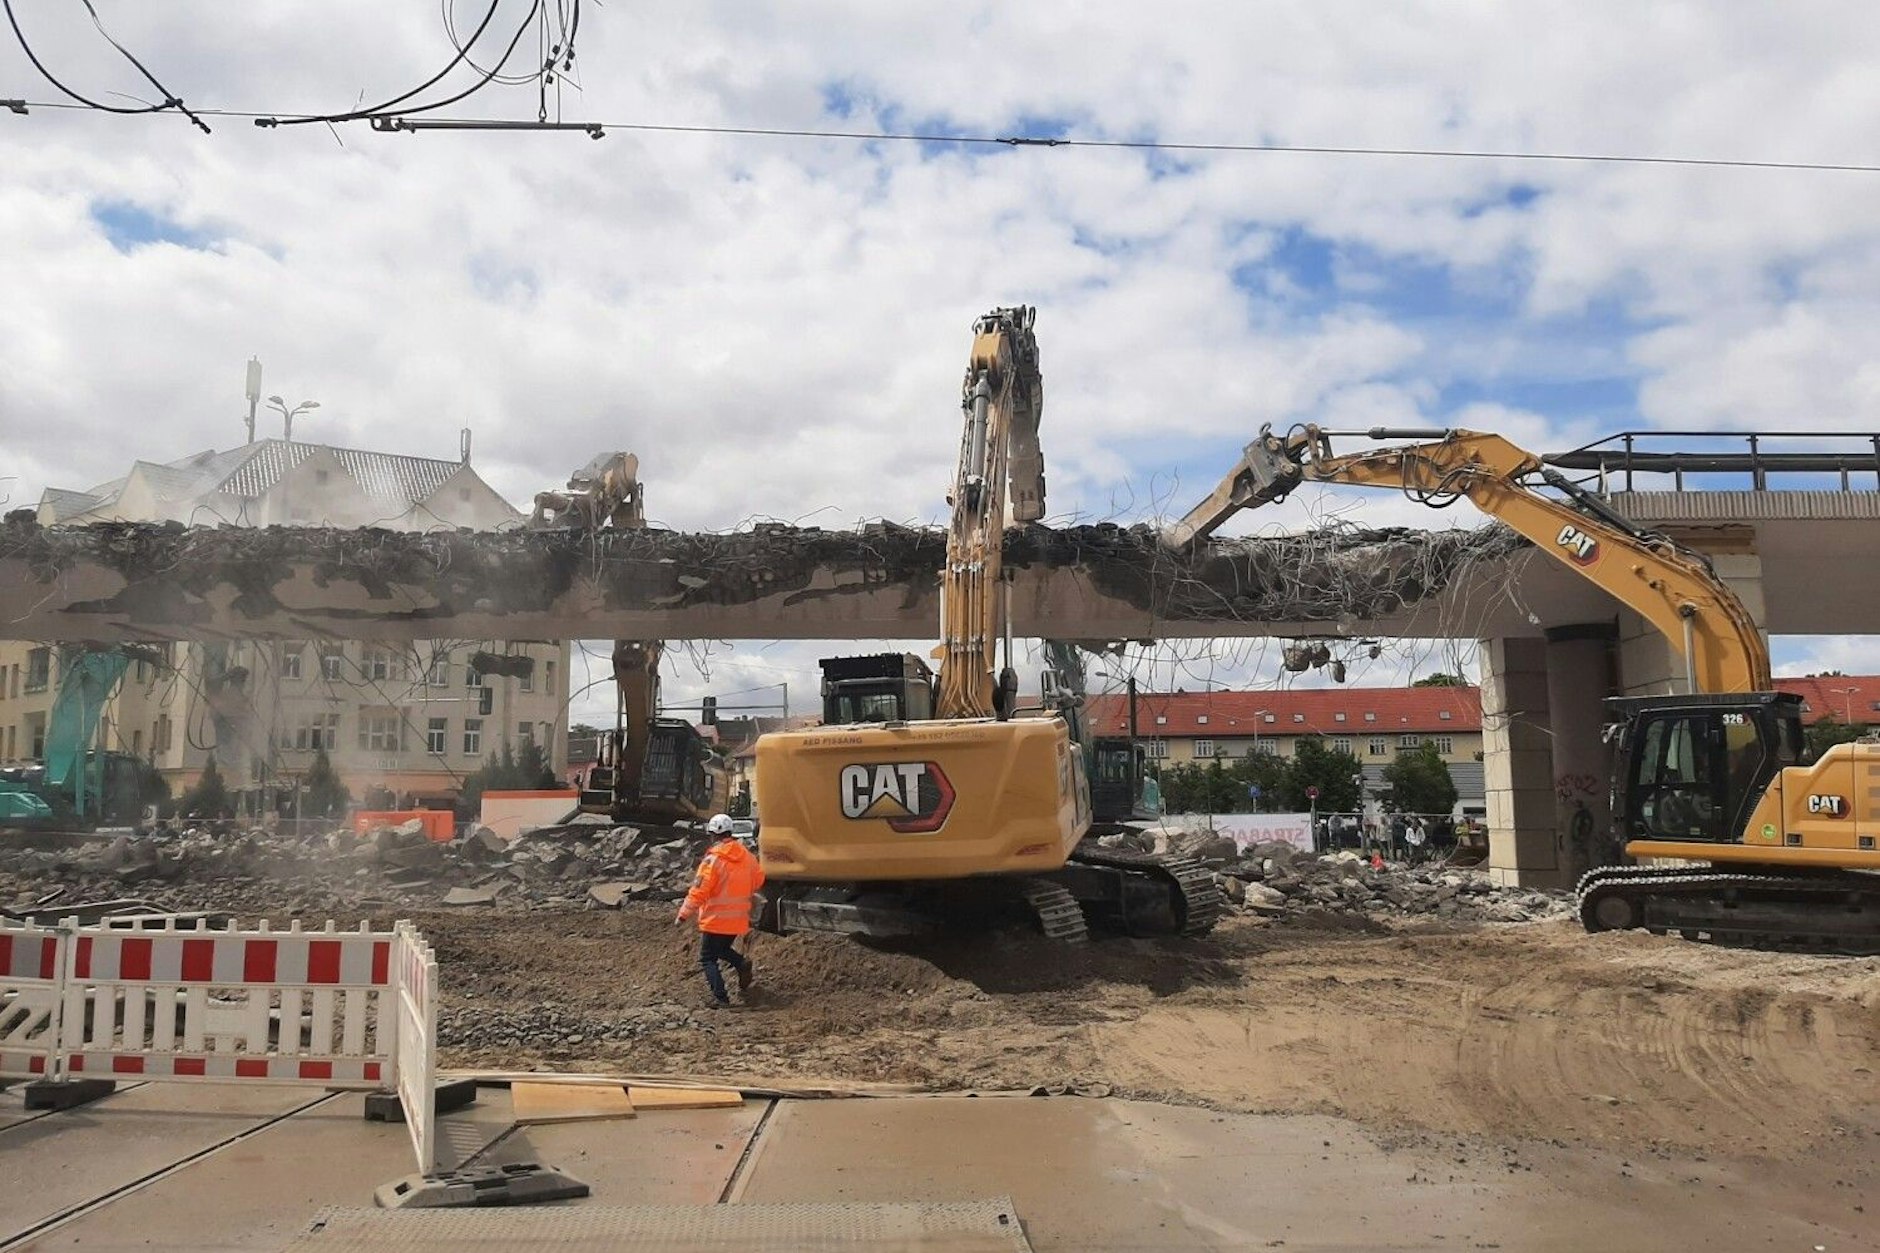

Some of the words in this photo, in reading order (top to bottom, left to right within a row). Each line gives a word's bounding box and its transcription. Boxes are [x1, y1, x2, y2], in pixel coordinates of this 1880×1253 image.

[1556, 525, 1596, 558] CAT
[1722, 713, 1744, 725] 326
[841, 763, 926, 818] CAT
[1808, 794, 1841, 814] CAT
